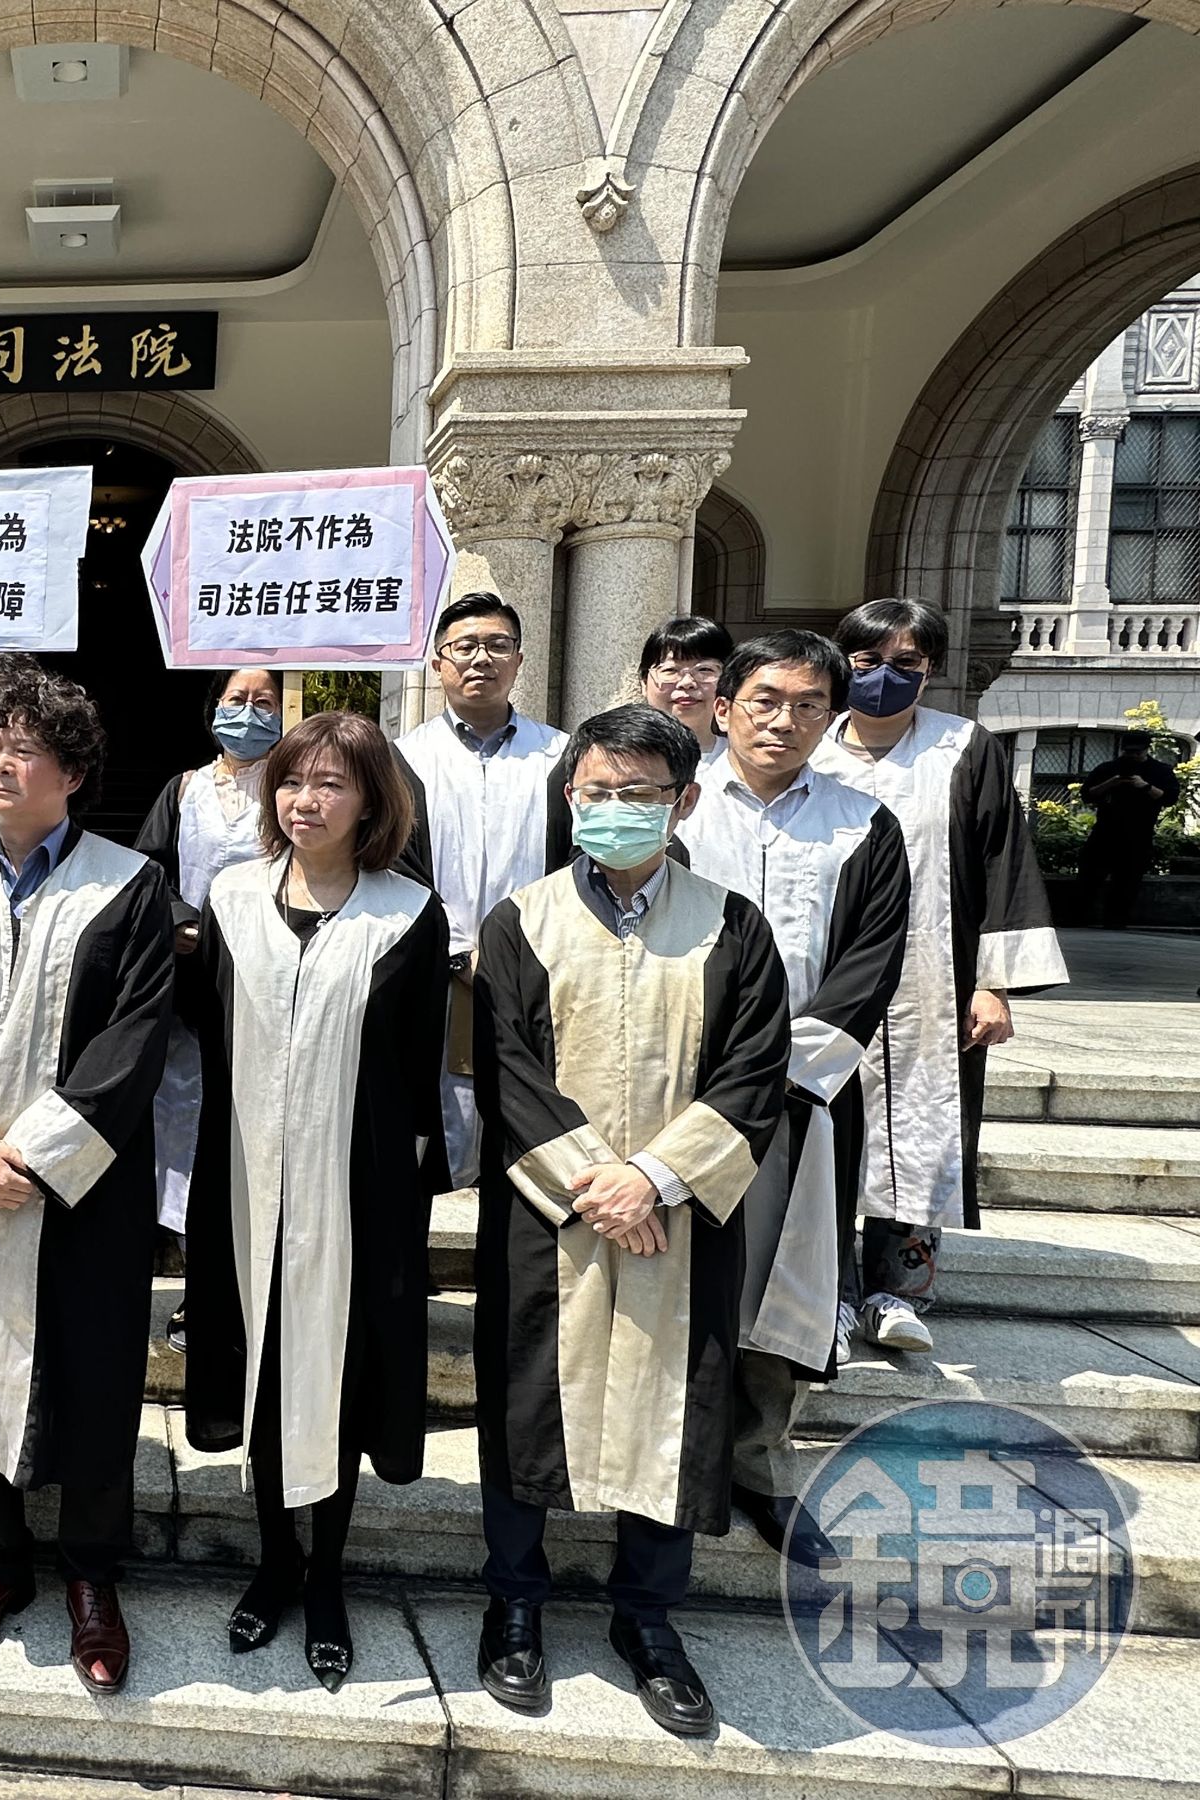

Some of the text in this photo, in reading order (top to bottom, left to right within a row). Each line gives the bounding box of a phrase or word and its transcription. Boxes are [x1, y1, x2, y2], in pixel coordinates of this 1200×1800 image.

[226, 513, 373, 553] 法院不作為
[198, 577, 403, 617] 司法信任受傷害
